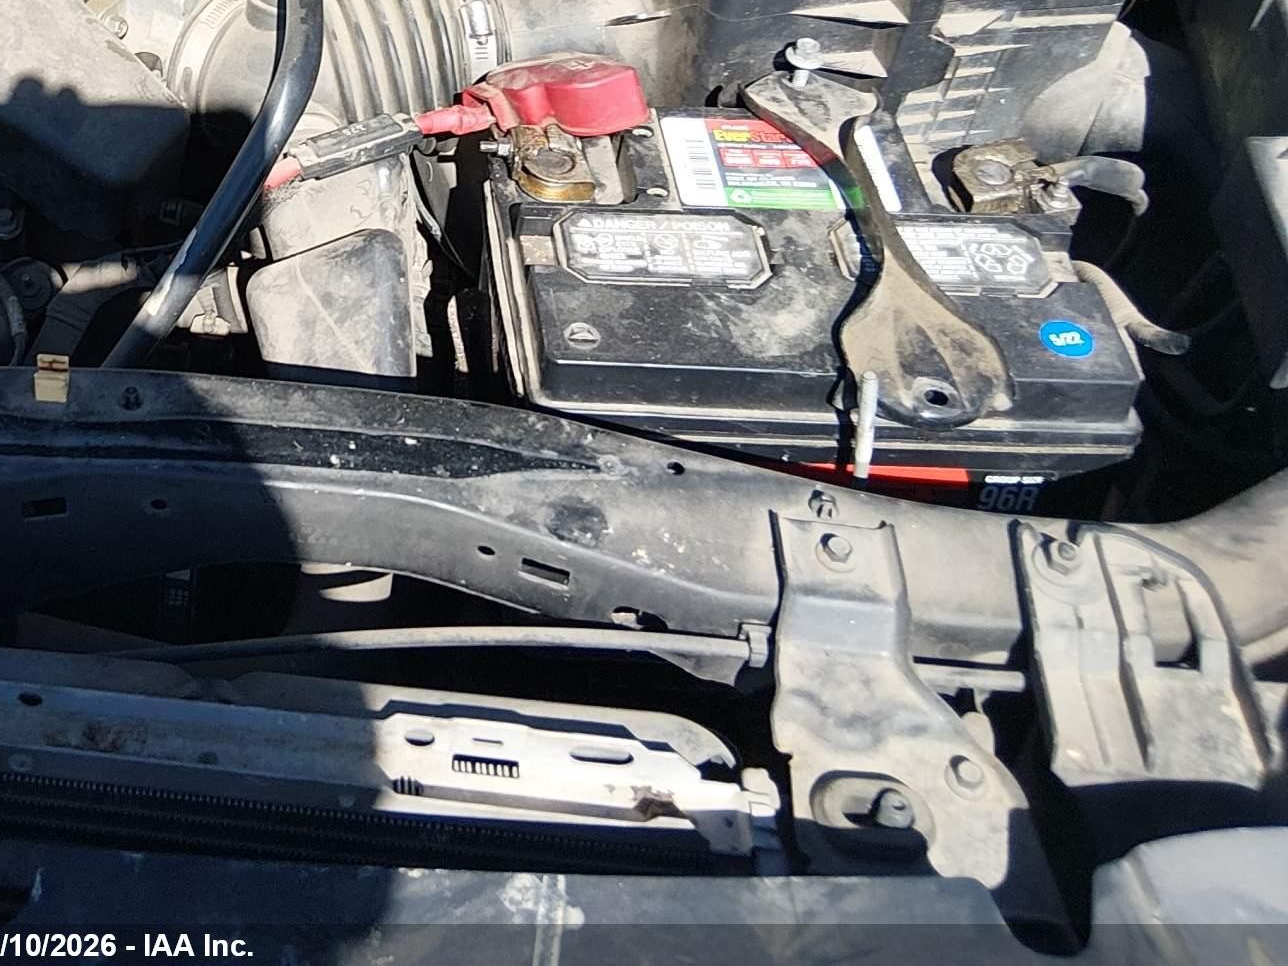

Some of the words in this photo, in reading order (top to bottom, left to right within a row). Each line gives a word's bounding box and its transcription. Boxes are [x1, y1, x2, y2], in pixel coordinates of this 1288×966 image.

[592, 218, 657, 230] DANGER
[671, 220, 730, 232] POISON
[980, 485, 1039, 511] 96R
